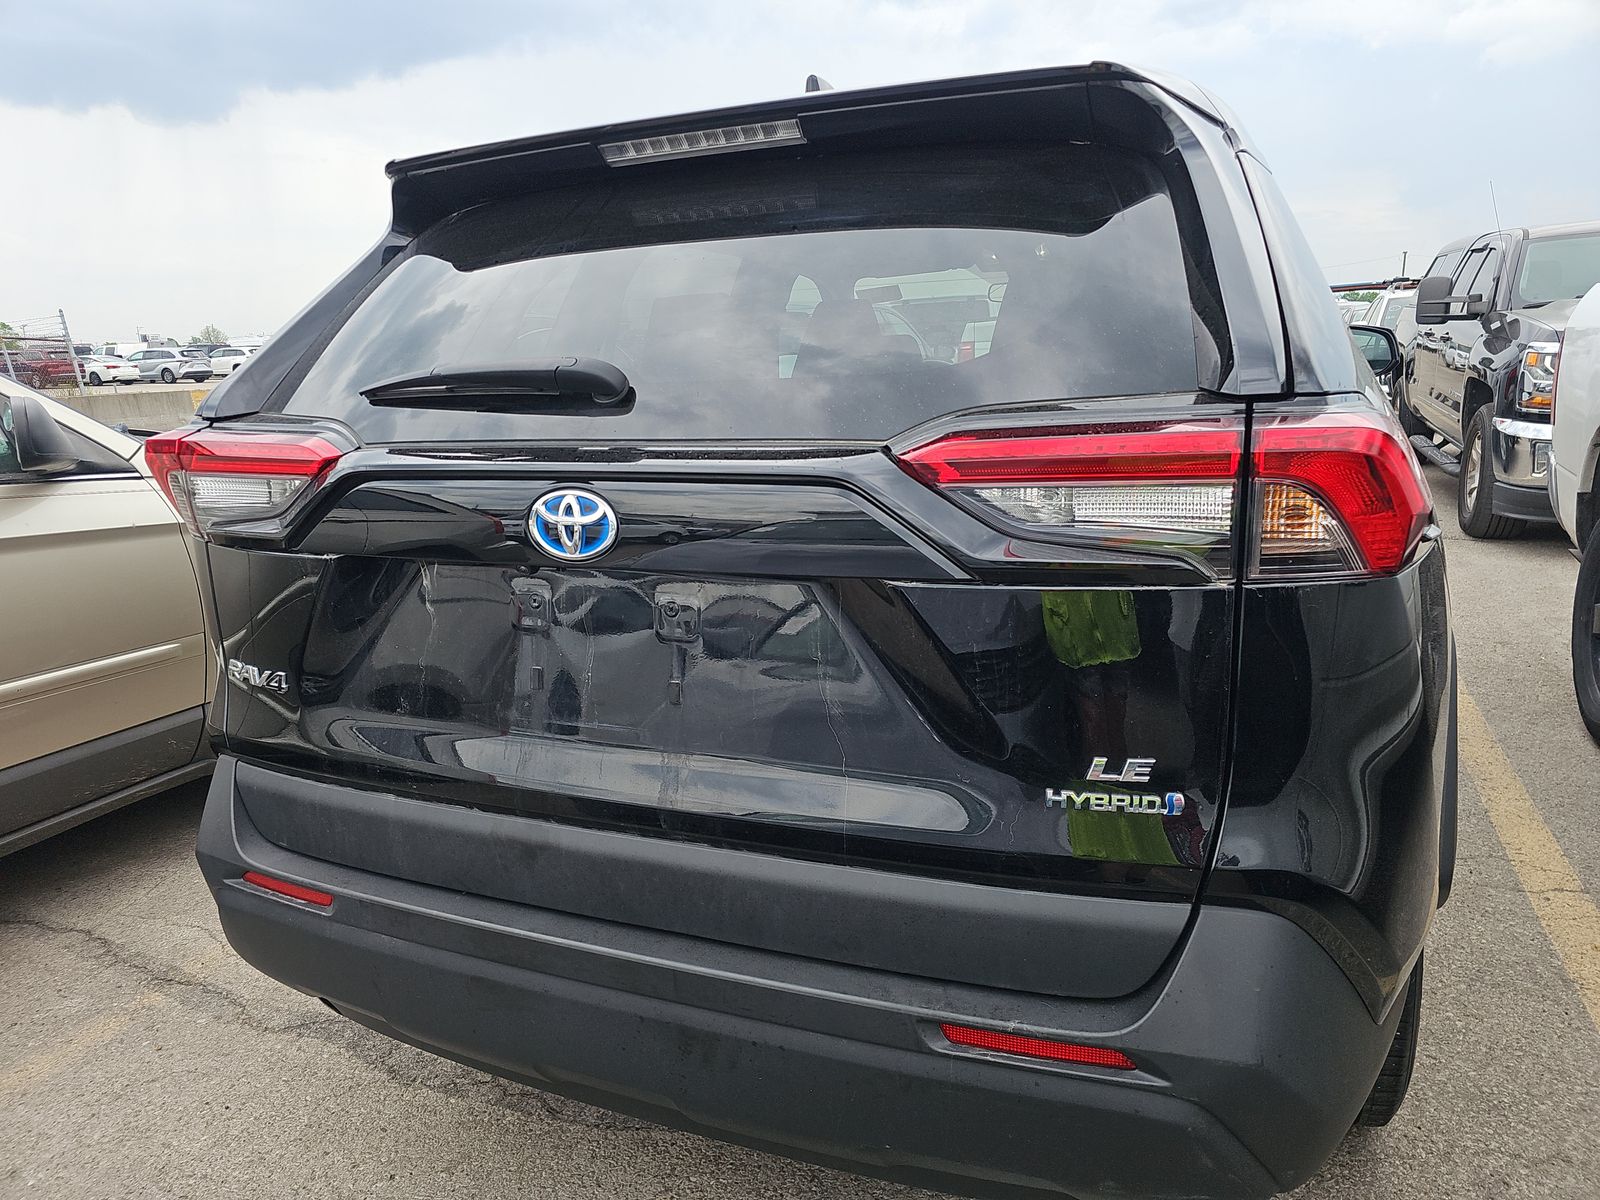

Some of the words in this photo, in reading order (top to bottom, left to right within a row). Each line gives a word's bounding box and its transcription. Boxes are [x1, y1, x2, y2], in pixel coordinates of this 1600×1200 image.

[228, 658, 289, 694] RAV4
[1085, 757, 1157, 782] LE
[1045, 787, 1165, 814] HYBRID
